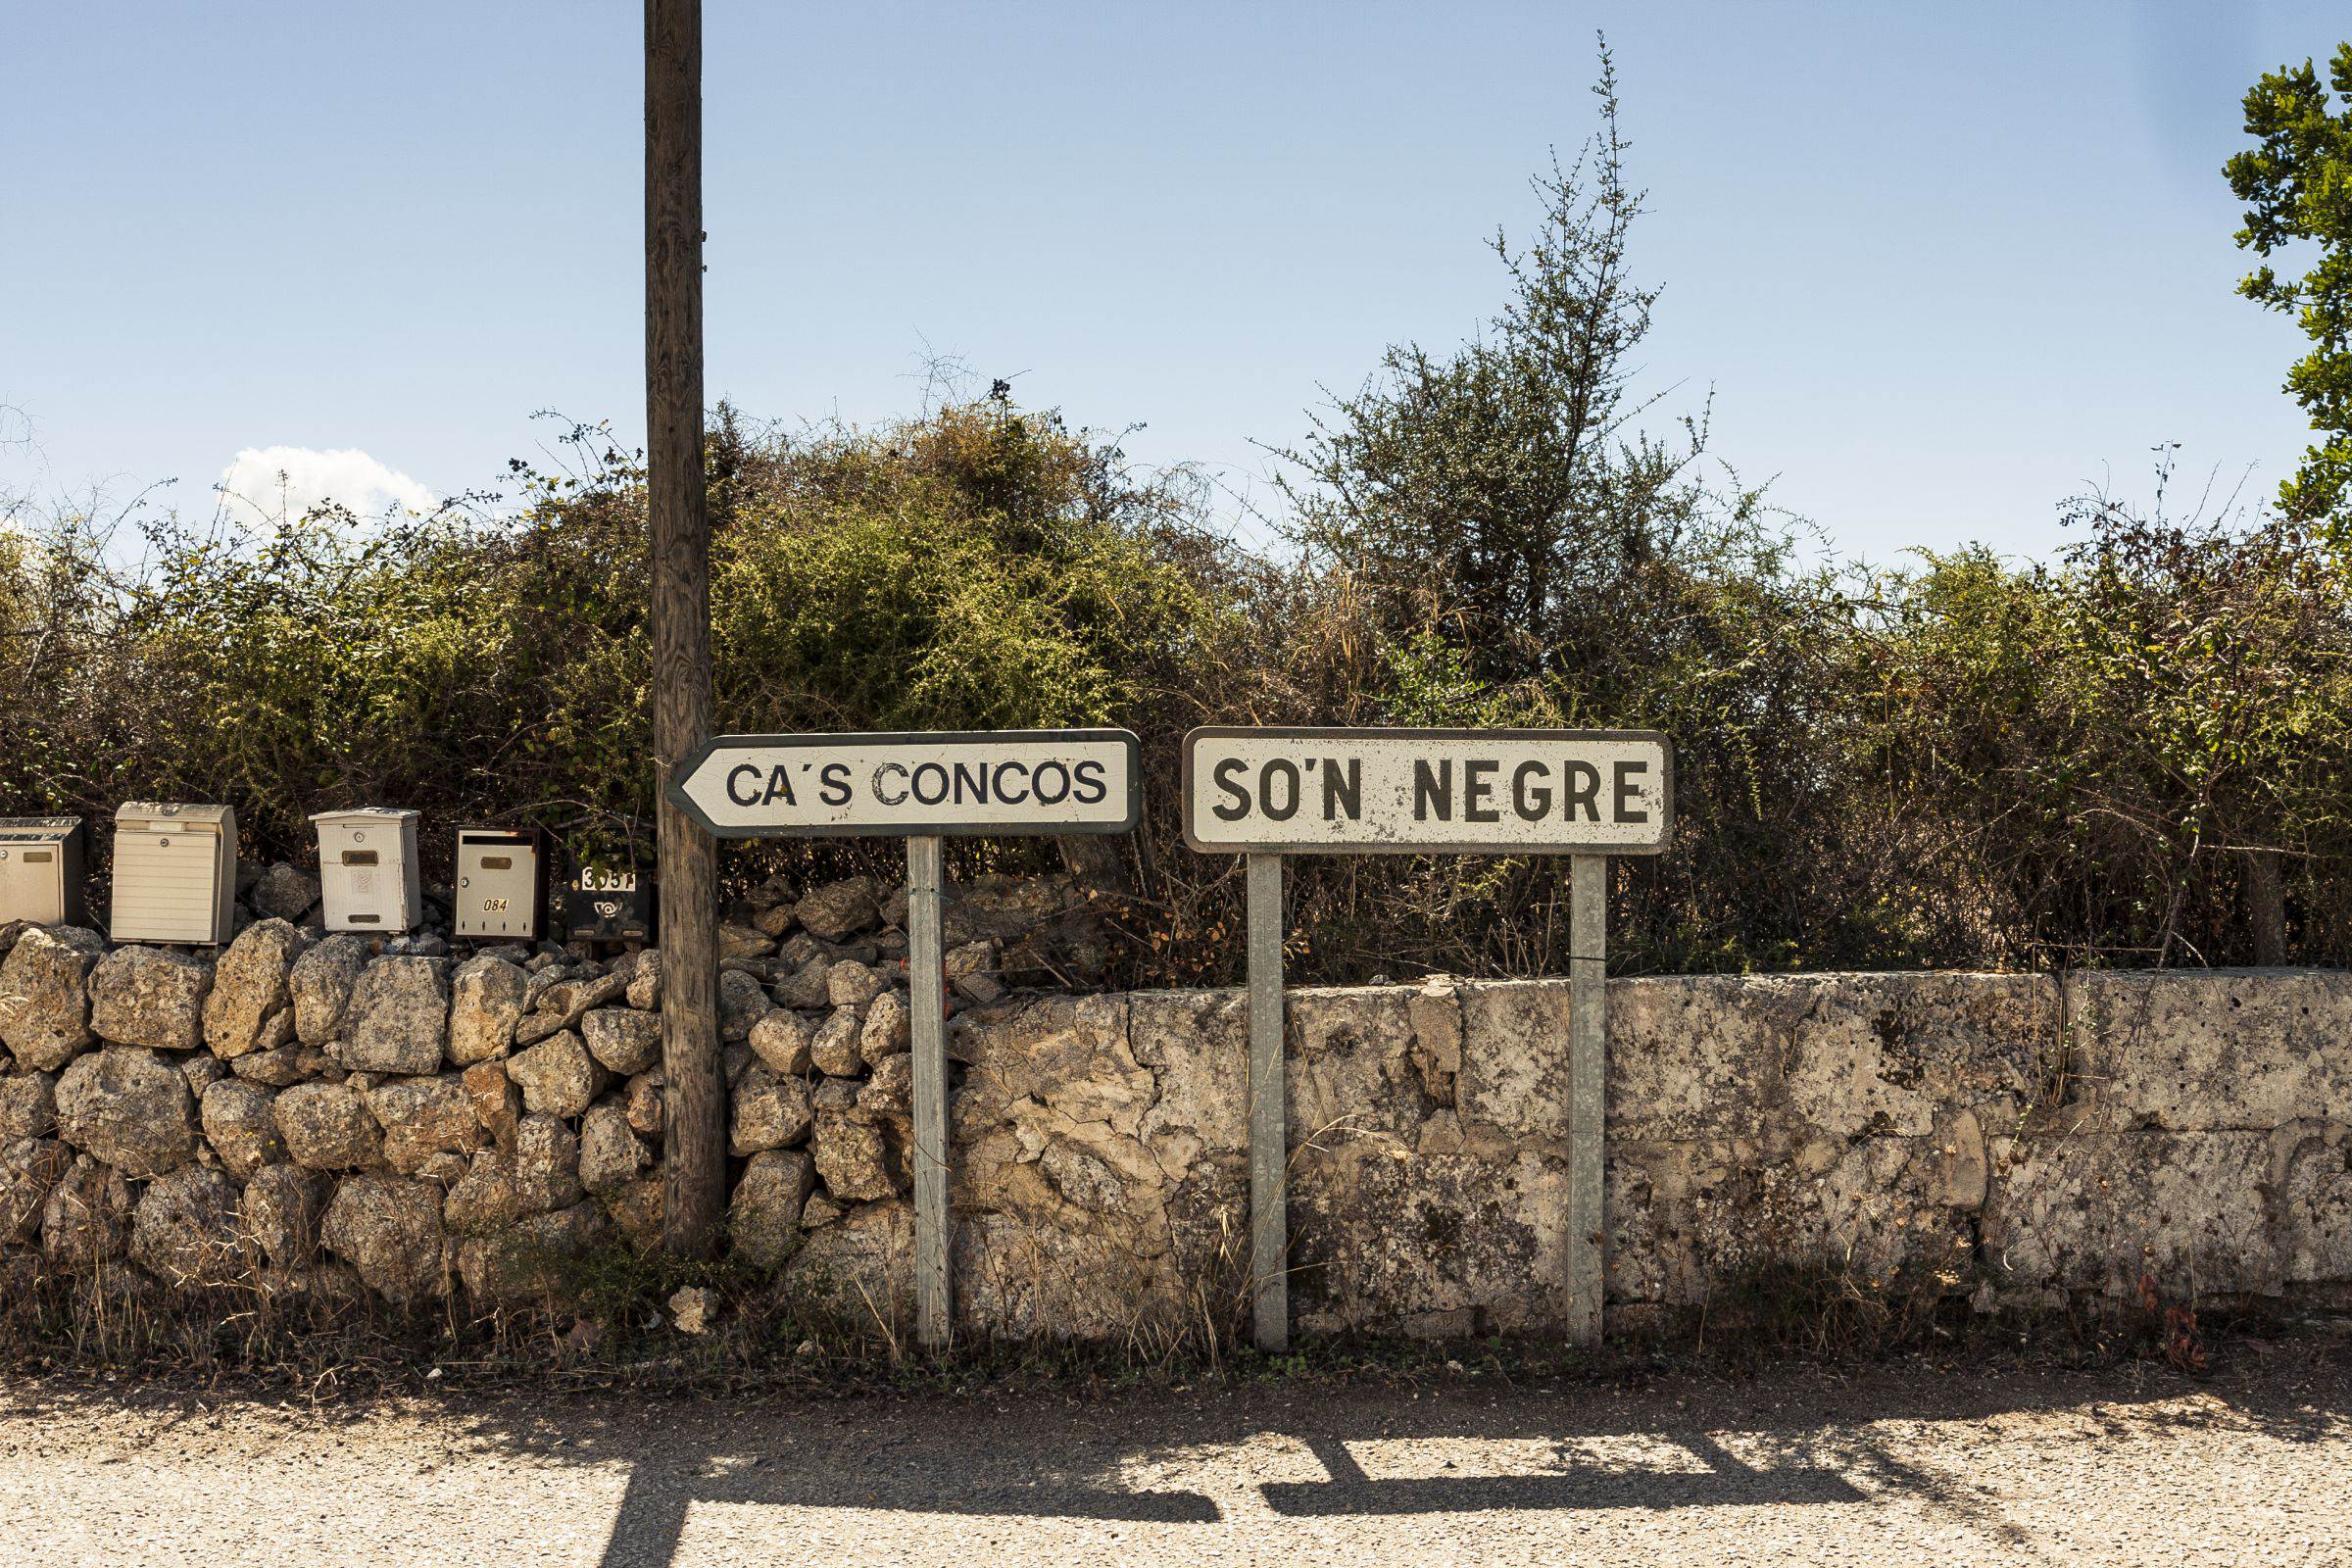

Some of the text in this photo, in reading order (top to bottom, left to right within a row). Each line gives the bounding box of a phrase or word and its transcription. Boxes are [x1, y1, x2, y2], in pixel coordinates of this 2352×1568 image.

[726, 760, 1107, 807] CA'S CONCOS
[1211, 758, 1648, 823] SO'N NEGRE
[484, 899, 508, 911] 084
